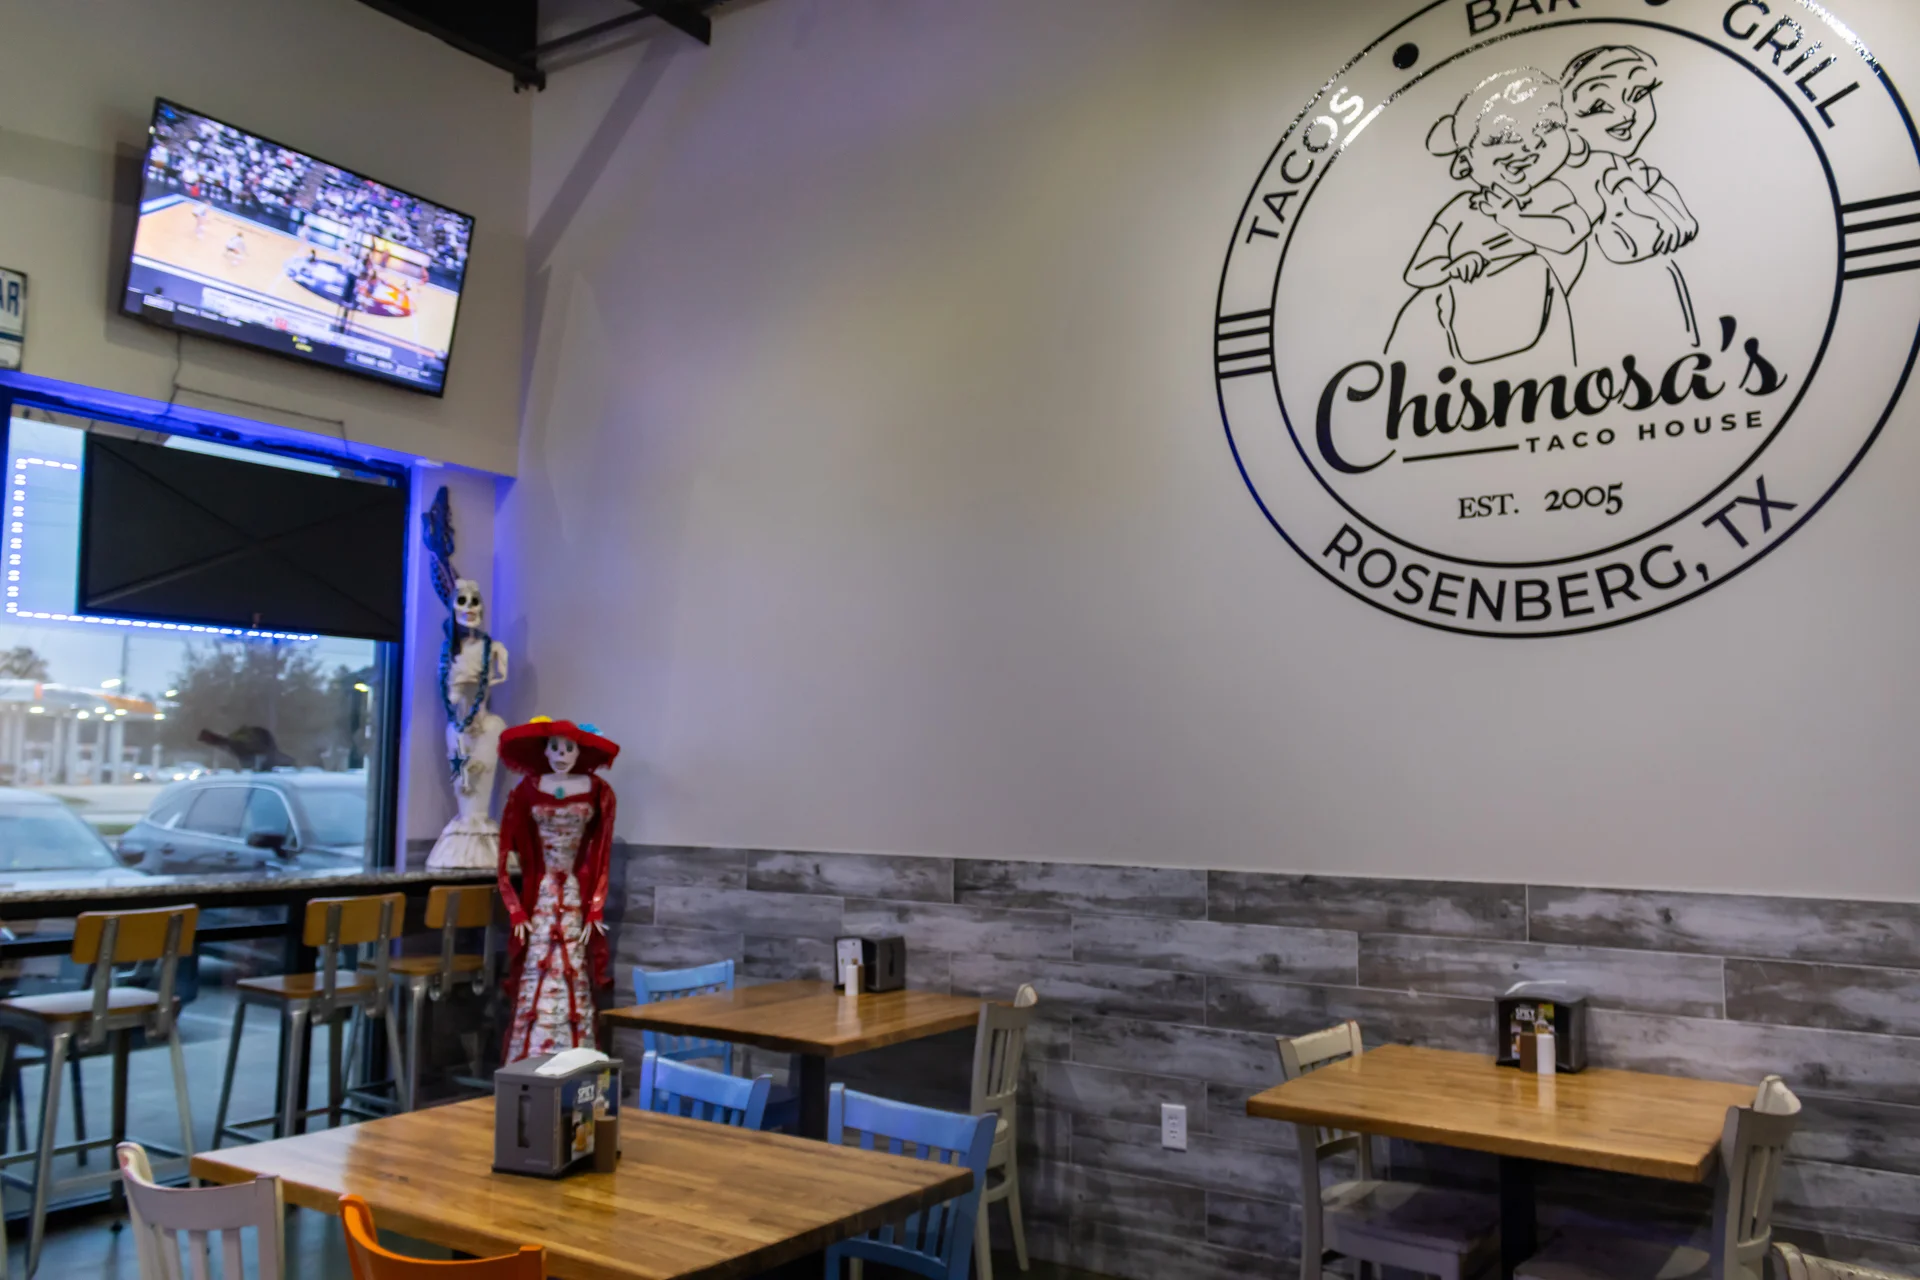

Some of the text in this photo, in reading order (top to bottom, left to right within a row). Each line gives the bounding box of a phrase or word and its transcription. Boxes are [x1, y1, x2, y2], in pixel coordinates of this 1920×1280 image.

[1246, 86, 1364, 243] TACOS
[1722, 0, 1860, 129] GRILL
[1316, 315, 1787, 473] Chismosa's
[1526, 411, 1763, 453] TACO HOUSE
[1322, 474, 1798, 622] ROSENBERG, TX
[1458, 482, 1624, 519] EST. 2005
